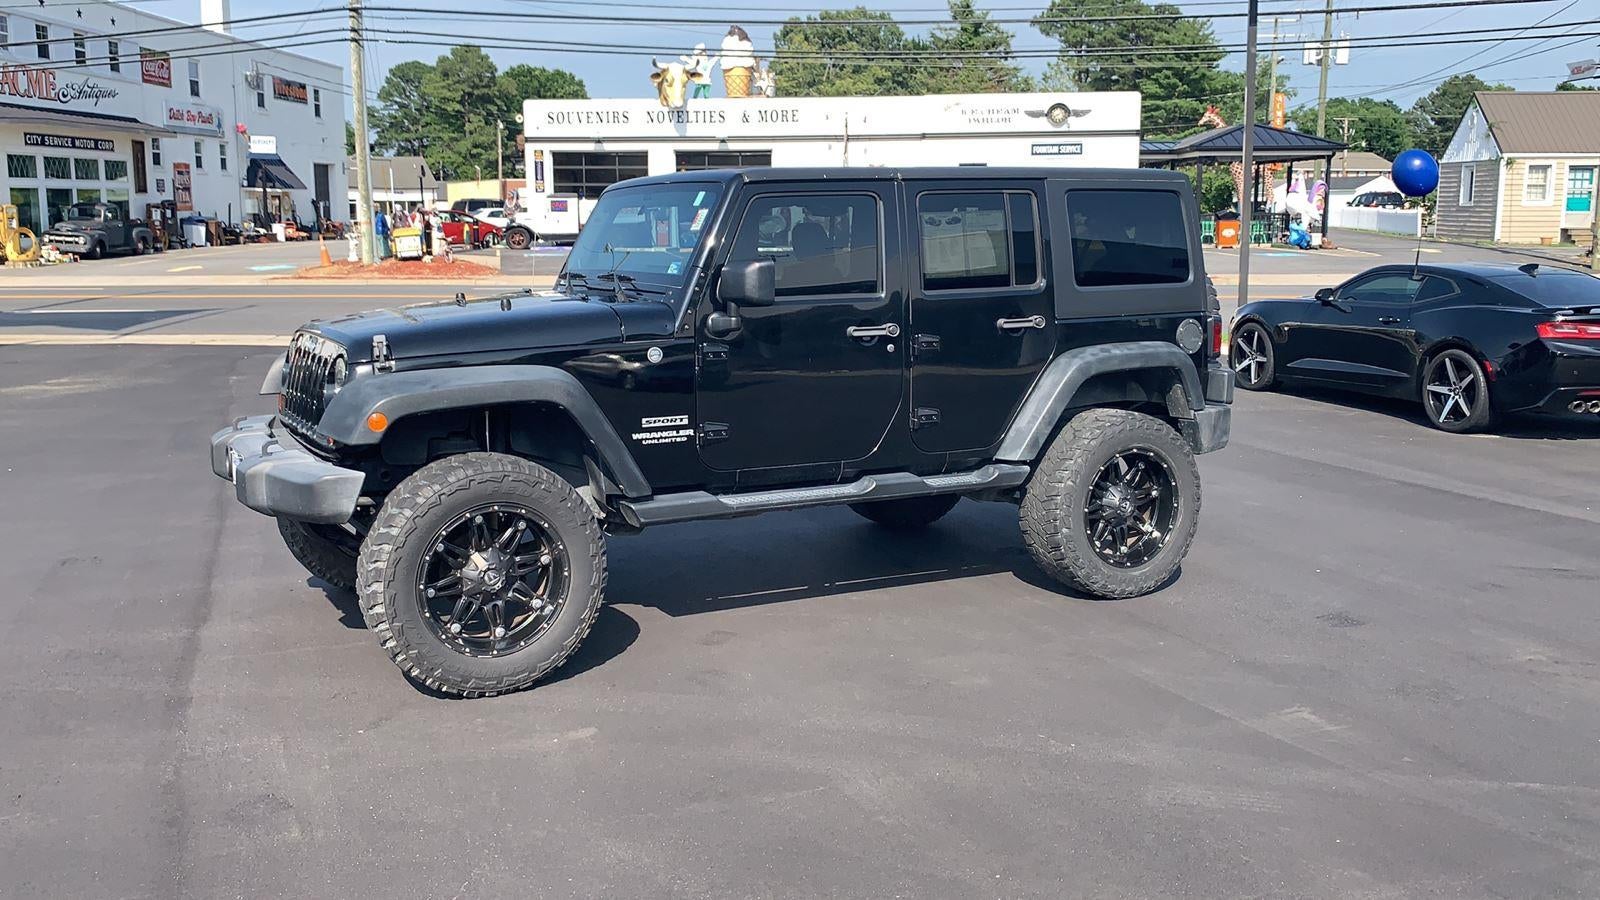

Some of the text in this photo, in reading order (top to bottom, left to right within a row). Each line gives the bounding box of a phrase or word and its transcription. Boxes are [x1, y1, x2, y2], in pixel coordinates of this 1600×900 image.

[0, 63, 57, 101] ACME
[70, 77, 119, 107] Antiques
[547, 108, 800, 125] SOUVENIRS NOVELTIES & MORE
[25, 134, 41, 145] CITY
[44, 136, 73, 147] SERVICE
[75, 139, 95, 149] MOTOR
[1033, 144, 1081, 154] FOUNTAIN SERVICE
[644, 417, 686, 425] SPORT
[632, 429, 694, 440] WRANGLER
[642, 436, 687, 445] UNLIMITED
